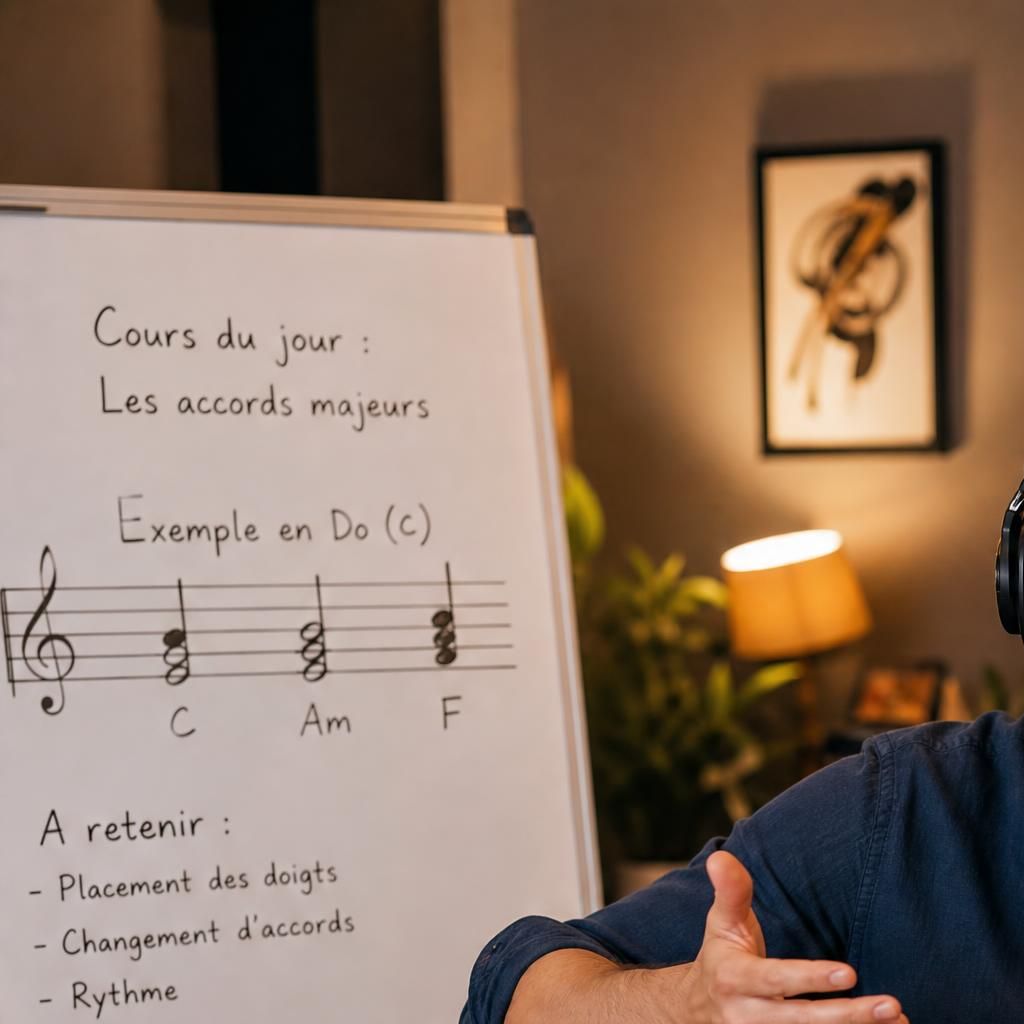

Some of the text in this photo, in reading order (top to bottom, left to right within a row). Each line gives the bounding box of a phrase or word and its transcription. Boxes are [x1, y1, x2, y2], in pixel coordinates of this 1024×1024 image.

[93, 304, 197, 351] Cours
[216, 316, 257, 351] du
[275, 324, 343, 368] jour
[99, 375, 430, 433] Les accords majeurs
[117, 493, 260, 558] Exemple
[278, 523, 313, 543] en
[330, 507, 369, 542] Do
[169, 694, 463, 739] C Am F
[39, 808, 66, 847] A
[86, 809, 205, 844] retenir
[58, 869, 193, 903] Placement
[208, 865, 250, 891] des
[263, 860, 338, 896] doigts
[61, 919, 220, 963] Changement
[237, 908, 355, 942] d'accords
[71, 978, 179, 1020] Rythme
